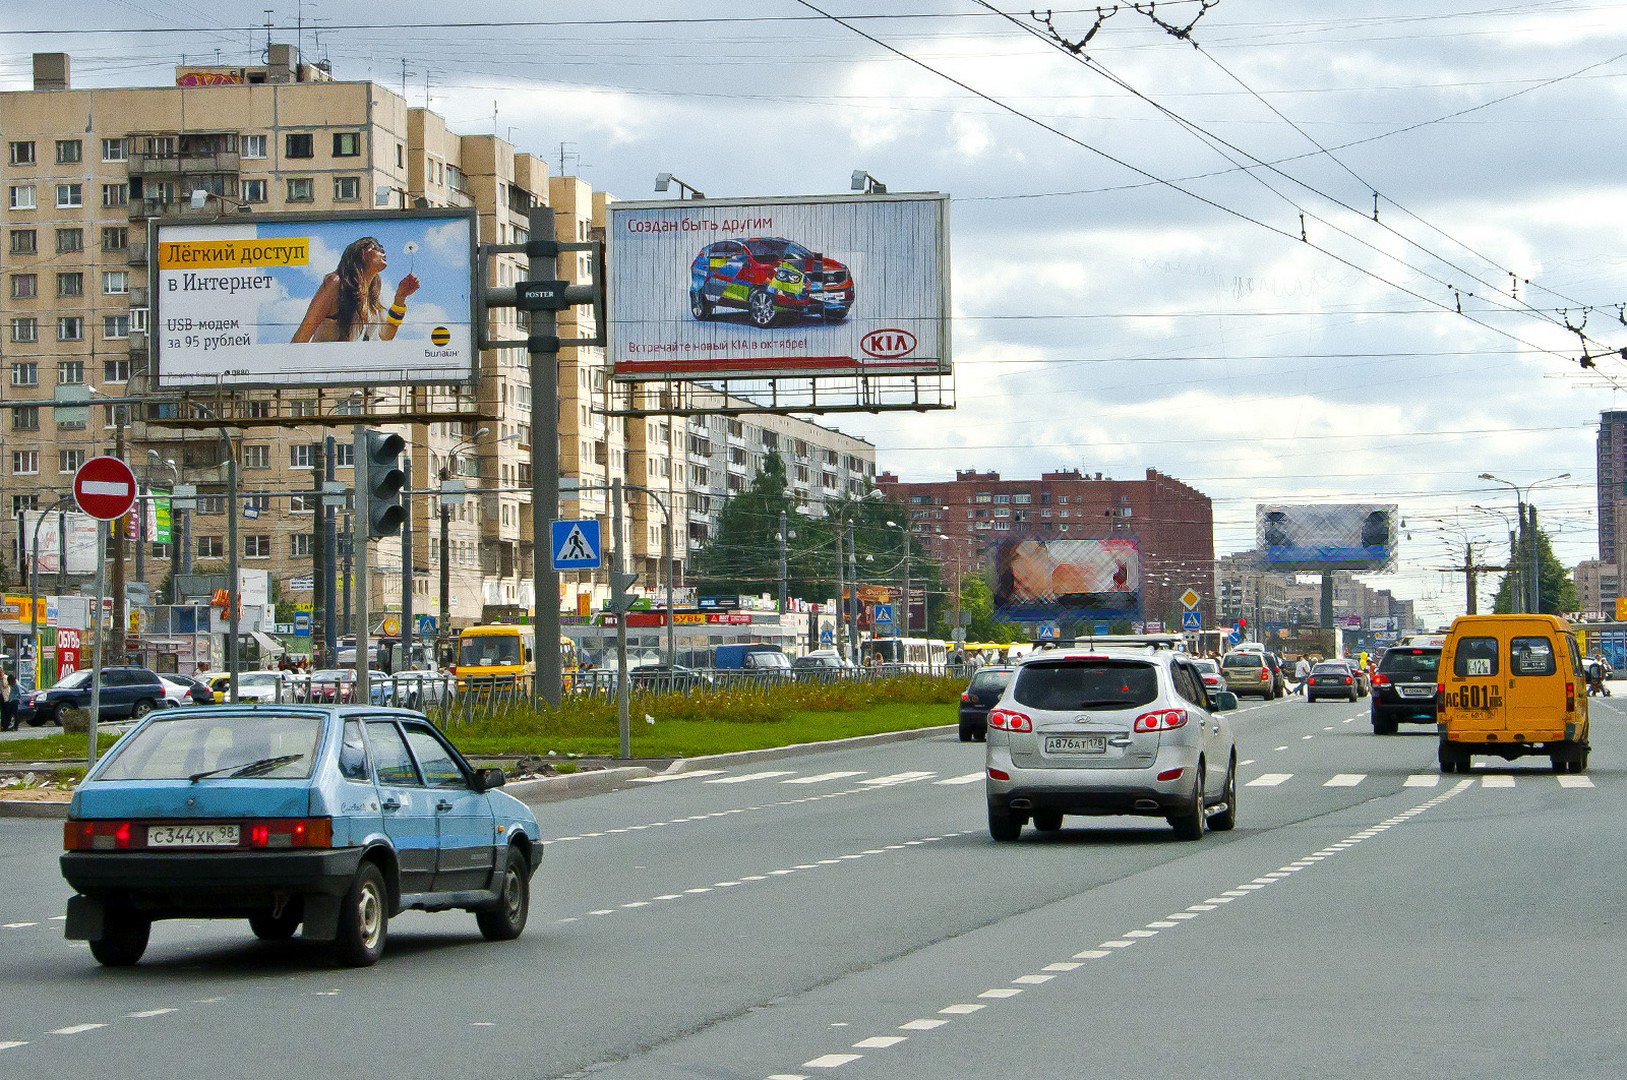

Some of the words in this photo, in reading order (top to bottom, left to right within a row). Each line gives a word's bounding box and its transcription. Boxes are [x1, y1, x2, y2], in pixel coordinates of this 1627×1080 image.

[627, 218, 678, 233] Создан
[681, 217, 719, 232] быть
[721, 217, 773, 234] другим
[167, 243, 236, 263] Лёгкий
[240, 245, 305, 264] доступ
[167, 278, 178, 292] в
[182, 273, 273, 295] Интернет
[167, 339, 181, 349] за
[185, 335, 200, 348] 95
[203, 333, 251, 351] рублей
[628, 341, 691, 355] Встречайте
[693, 340, 728, 351] новый
[731, 340, 749, 350] KIA
[751, 342, 758, 350] в
[760, 339, 808, 350] октябре!
[871, 335, 908, 351] KIA
[424, 348, 458, 358] Билайн
[58, 630, 80, 648] ОБУВЬ
[1049, 739, 1087, 748] А876АТ
[1089, 739, 1104, 747] 178
[154, 827, 215, 843] С344ХК
[219, 826, 234, 838] 98
